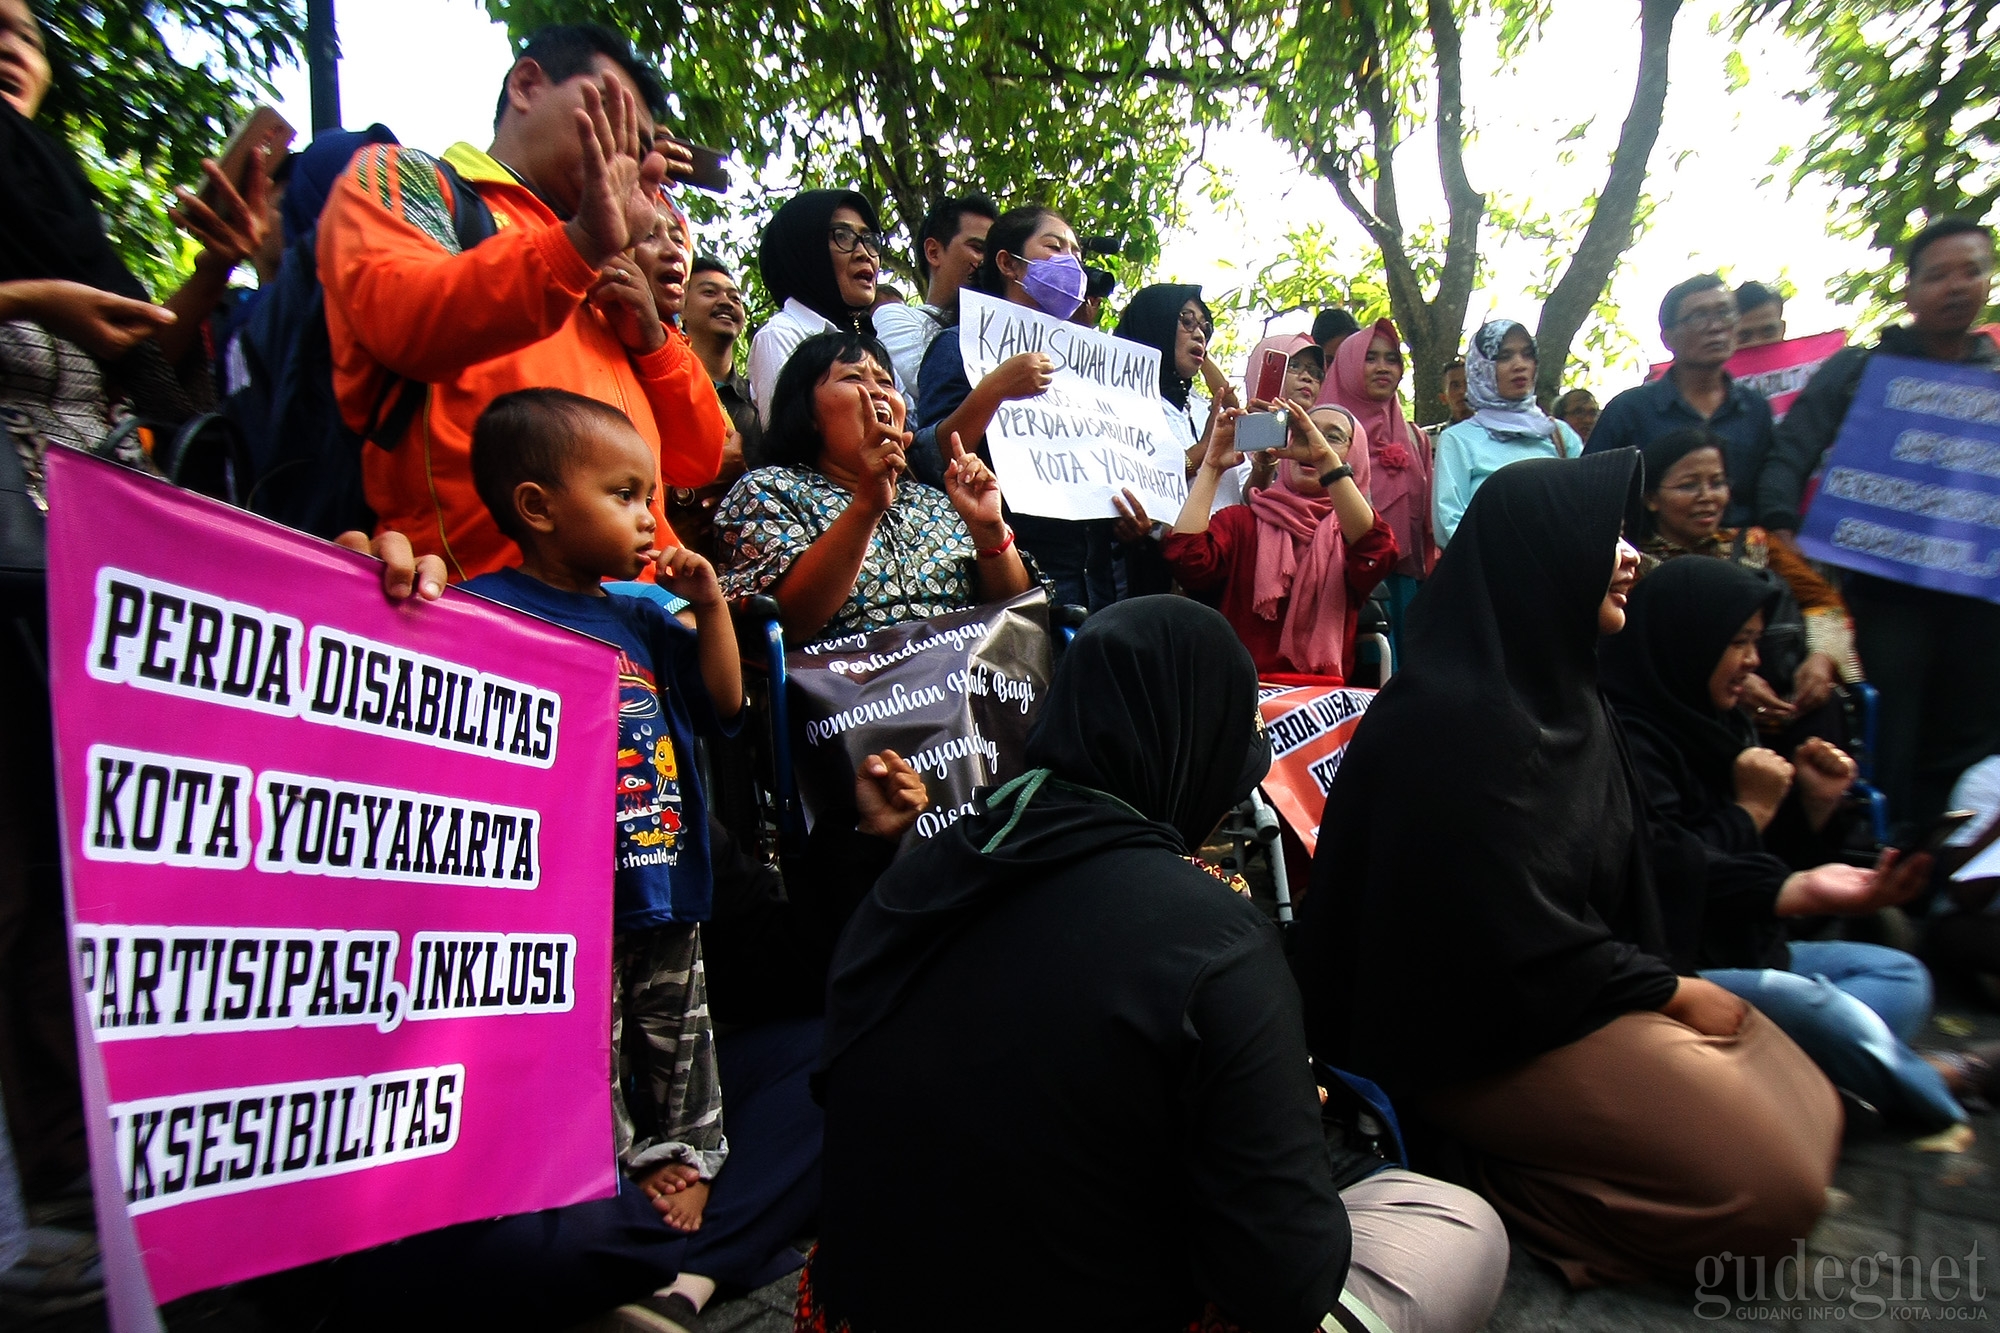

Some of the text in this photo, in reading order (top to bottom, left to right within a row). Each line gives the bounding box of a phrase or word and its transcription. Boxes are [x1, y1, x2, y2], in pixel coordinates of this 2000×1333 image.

[1048, 328, 1106, 386] SUDAH
[1110, 347, 1157, 400] LAMA
[997, 406, 1156, 457] PERDA DISABILITAS
[1028, 447, 1089, 485] KOTA
[98, 577, 558, 763] PERDA DISABILITAS
[828, 622, 991, 675] Perlindungan
[806, 664, 1036, 747] Pemenuhan Hak Bagi
[1268, 708, 1322, 755] ERDA
[93, 757, 536, 882] KOTA YOGYAKARTA
[413, 941, 570, 1011] INKLUSI
[113, 1073, 458, 1204] KSESIBILITAS
